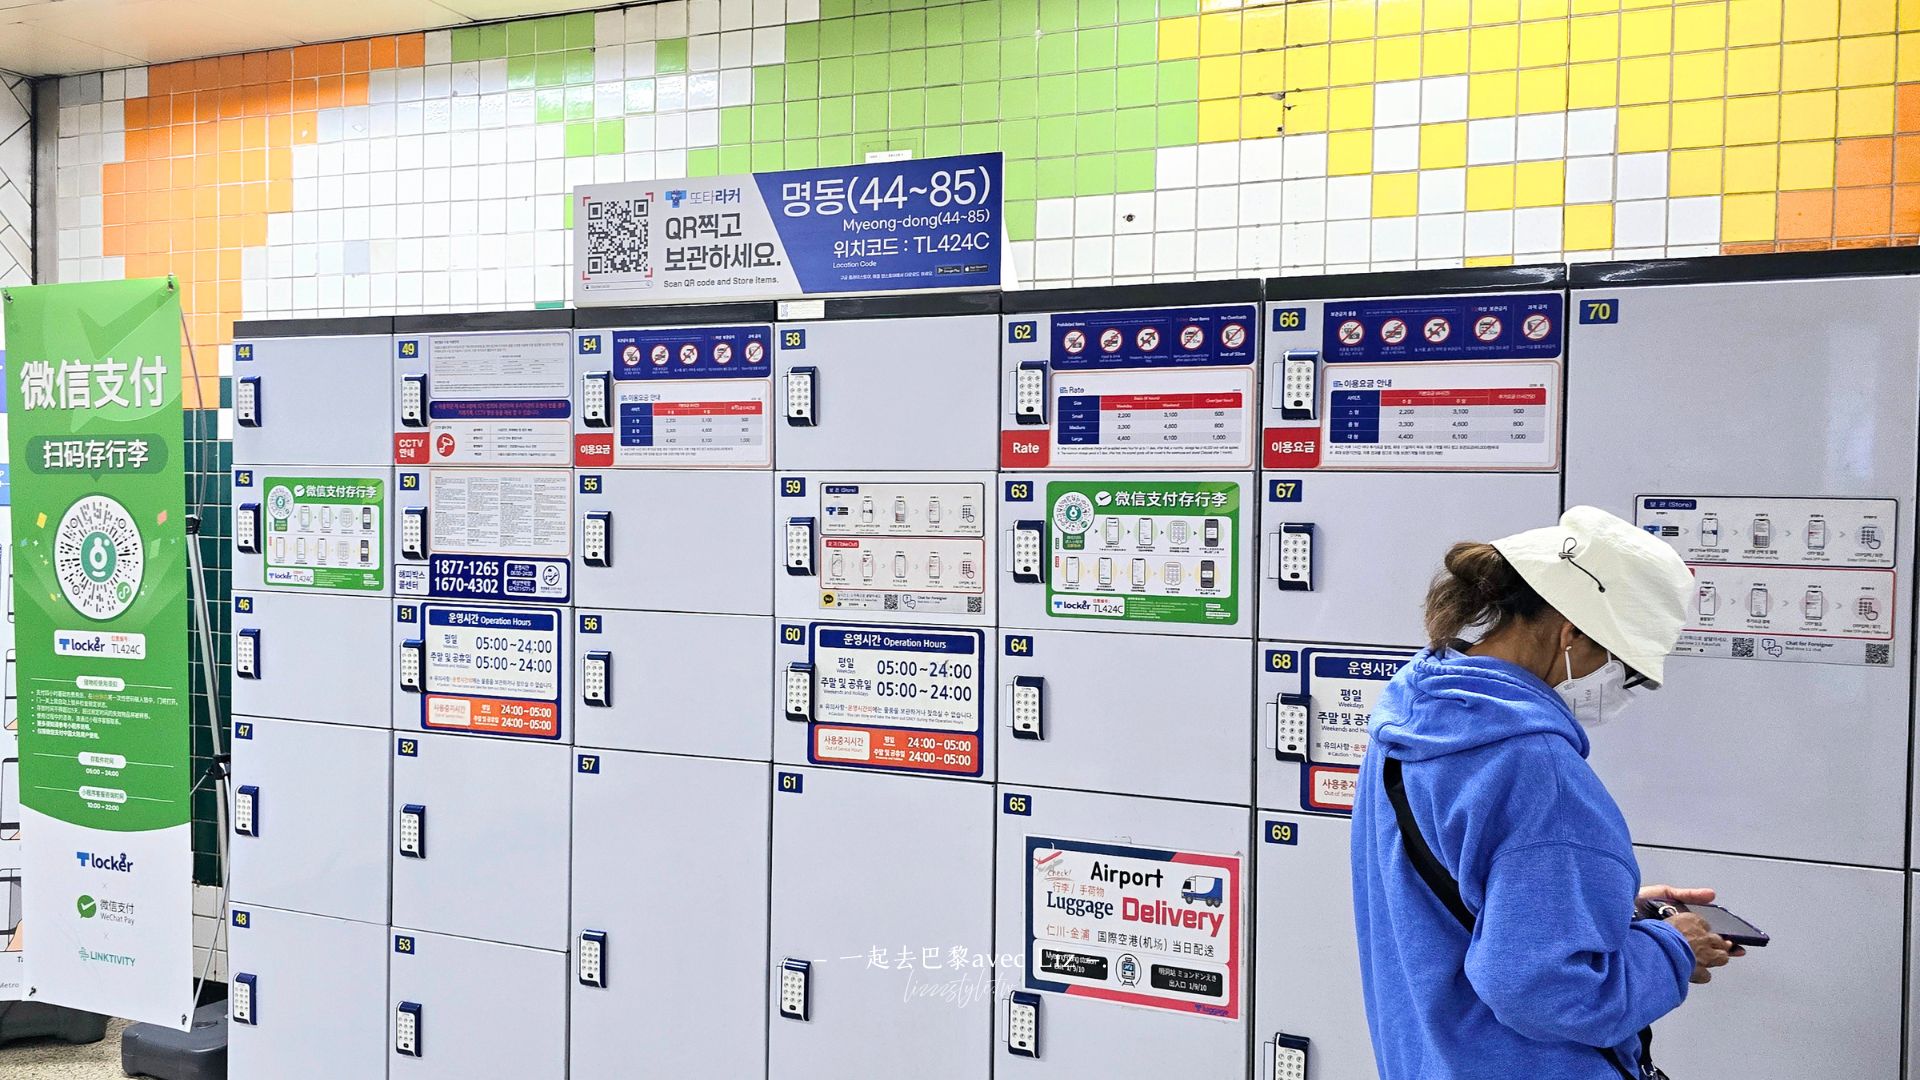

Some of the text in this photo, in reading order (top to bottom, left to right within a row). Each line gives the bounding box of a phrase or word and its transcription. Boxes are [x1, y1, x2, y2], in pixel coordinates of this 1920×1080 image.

[690, 188, 741, 205] 또타라커
[782, 166, 991, 217] 명동(44~85)
[666, 213, 742, 240] QR찍고
[844, 208, 990, 234] Myeong-dong(44~85)
[833, 232, 990, 258] 위치코드 TL424C
[664, 242, 782, 272] 보관하세요.
[833, 261, 858, 269] Location
[664, 280, 683, 288] Scan
[684, 280, 695, 288] QR
[697, 279, 715, 287] code
[717, 278, 731, 286] and
[733, 277, 753, 285] Store
[1588, 303, 1611, 320] 70
[1280, 312, 1299, 328] 66
[786, 332, 800, 346] 58
[1014, 325, 1031, 340] 62
[402, 343, 415, 355] 49
[584, 338, 597, 351] 54
[238, 346, 250, 358] 44
[20, 356, 168, 411] 微信支付
[1344, 379, 1392, 388] 이용요금 안내
[399, 439, 424, 448] CCTV
[580, 444, 611, 455] 이용요금
[1013, 442, 1040, 454] Rate
[1272, 441, 1316, 453] 이용요금
[43, 440, 149, 470] 扫码存行李
[399, 449, 415, 458] 안내
[238, 472, 250, 484] 45
[403, 476, 416, 488] 50
[306, 485, 376, 498] 微信支付存行李
[584, 479, 598, 491] 55
[786, 480, 800, 493] 59
[1011, 484, 1027, 498] 63
[1276, 484, 1295, 498] 67
[1115, 491, 1228, 508] 微信支付存行李
[399, 570, 426, 579] 해피박스
[435, 560, 499, 576] 1877-1265
[293, 575, 313, 583] TL424C
[435, 576, 499, 594] 1670-4302
[238, 599, 250, 611] 46
[1093, 604, 1124, 614] TL424C
[401, 608, 412, 620] 51
[448, 612, 531, 626] 운영시간 Operation Hours
[584, 619, 598, 631] 56
[786, 629, 800, 642] 60
[843, 634, 947, 649] 운영시간 Operation Hours
[112, 644, 141, 655] TL424C
[1011, 639, 1027, 653] 64
[838, 657, 854, 669] 평일
[1272, 654, 1291, 670] 68
[1348, 661, 1398, 677] 운영시간
[820, 677, 872, 691] 주말 및 공휴일
[1340, 689, 1362, 703] 평일
[1317, 711, 1352, 726] 주말 및
[238, 725, 250, 736] 47
[402, 742, 414, 754] 52
[1324, 742, 1350, 751] 유의사항
[582, 759, 596, 770] 57
[784, 776, 797, 789] 61
[1009, 798, 1026, 811] 65
[1271, 825, 1291, 841] 69
[1091, 861, 1163, 889] Airport
[1053, 882, 1070, 894] 行李
[1080, 884, 1105, 898] 手荷物
[100, 899, 134, 915] 微信支付
[101, 912, 135, 926] WeChat Pay
[236, 912, 246, 924] 48
[1047, 891, 1224, 937] Luggage Delivery
[399, 939, 410, 951] 53
[1046, 925, 1214, 958] 仁川-金浦 国際空港(机场) 当日配送
[90, 951, 136, 967] LINKTIVITY
[1177, 969, 1217, 983] ミョンドンえき
[1169, 980, 1207, 992] 出入口 1/9/10
